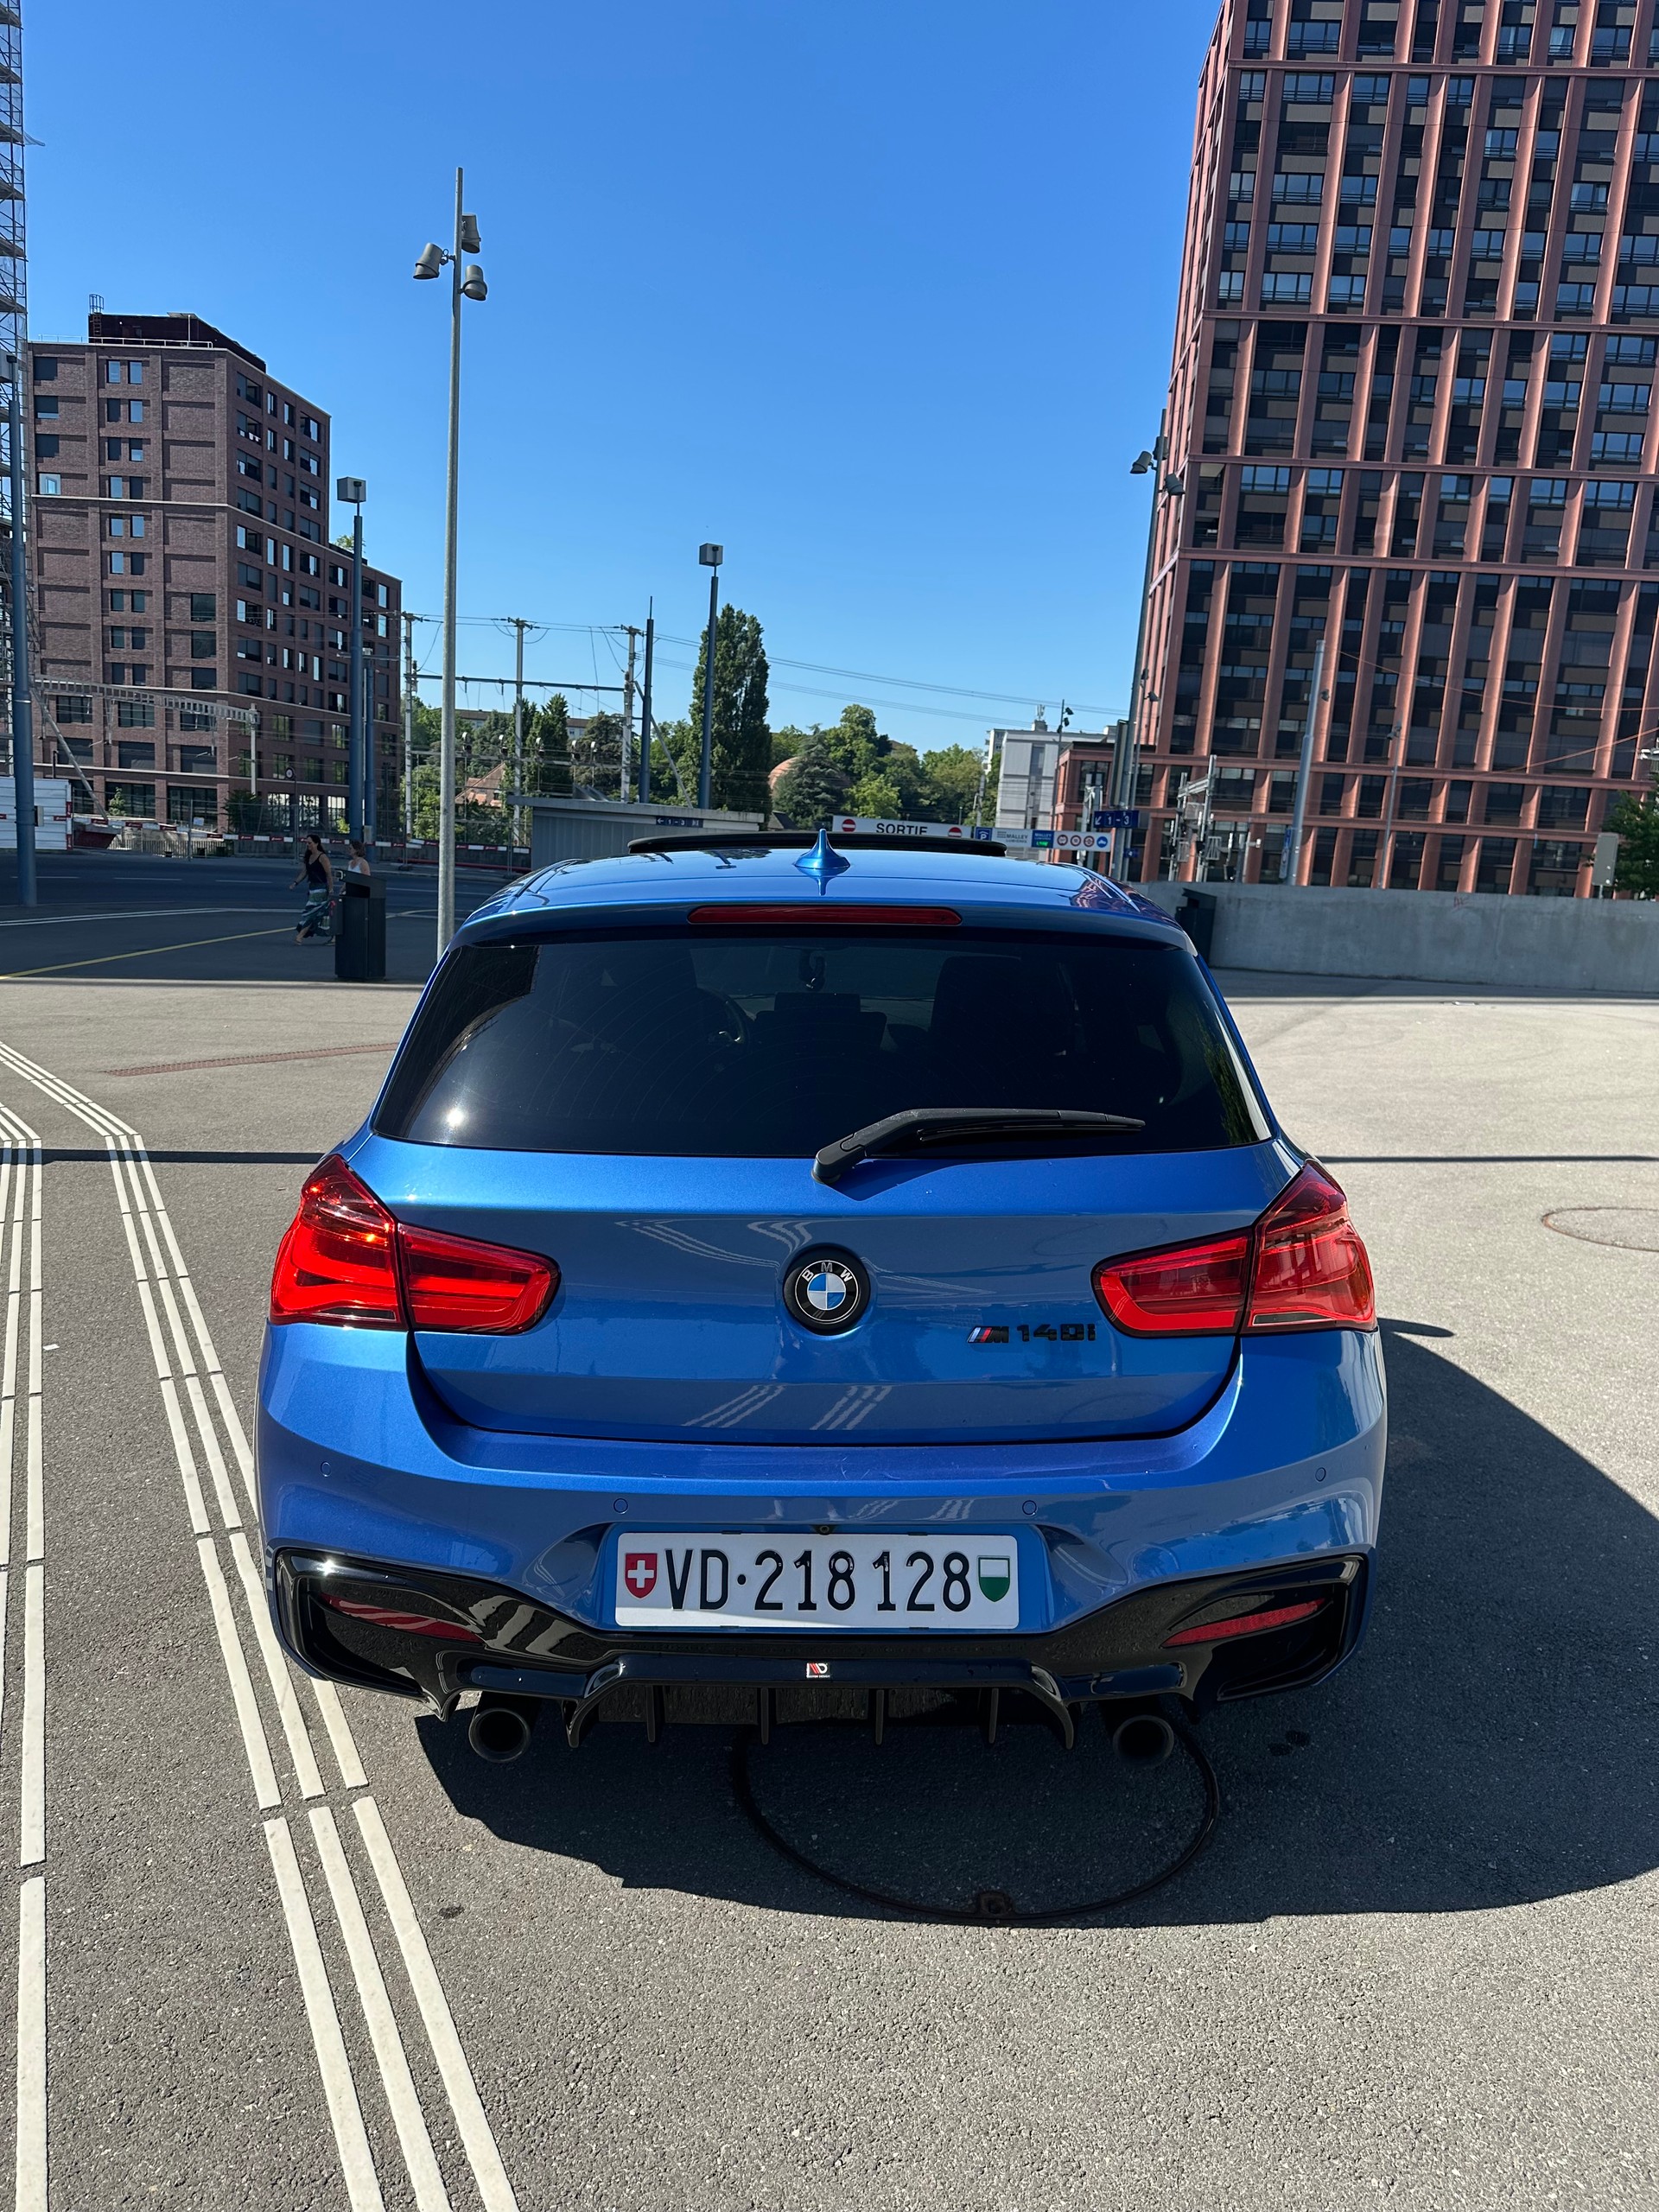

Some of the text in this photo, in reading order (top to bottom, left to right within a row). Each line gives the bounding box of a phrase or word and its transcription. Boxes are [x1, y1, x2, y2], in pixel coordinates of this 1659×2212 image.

[876, 823, 928, 836] SORTIE
[802, 1262, 853, 1282] BMW
[871, 1551, 972, 1612] 128
